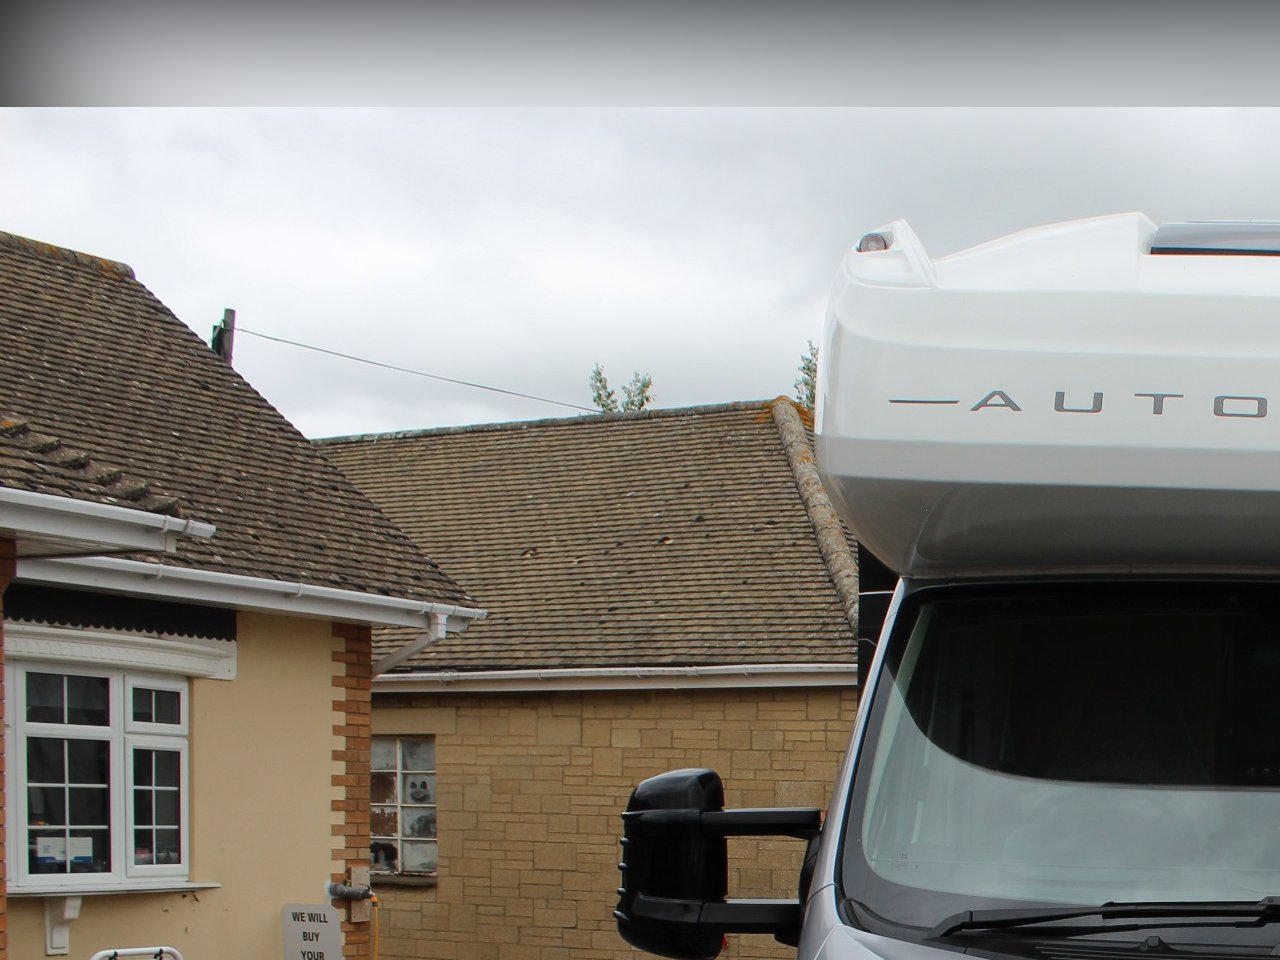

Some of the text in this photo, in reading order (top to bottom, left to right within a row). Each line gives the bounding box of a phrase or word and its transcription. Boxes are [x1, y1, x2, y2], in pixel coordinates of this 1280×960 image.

[292, 912, 328, 923] WE WILL
[302, 931, 320, 942] BUY
[301, 950, 325, 960] YOUR
